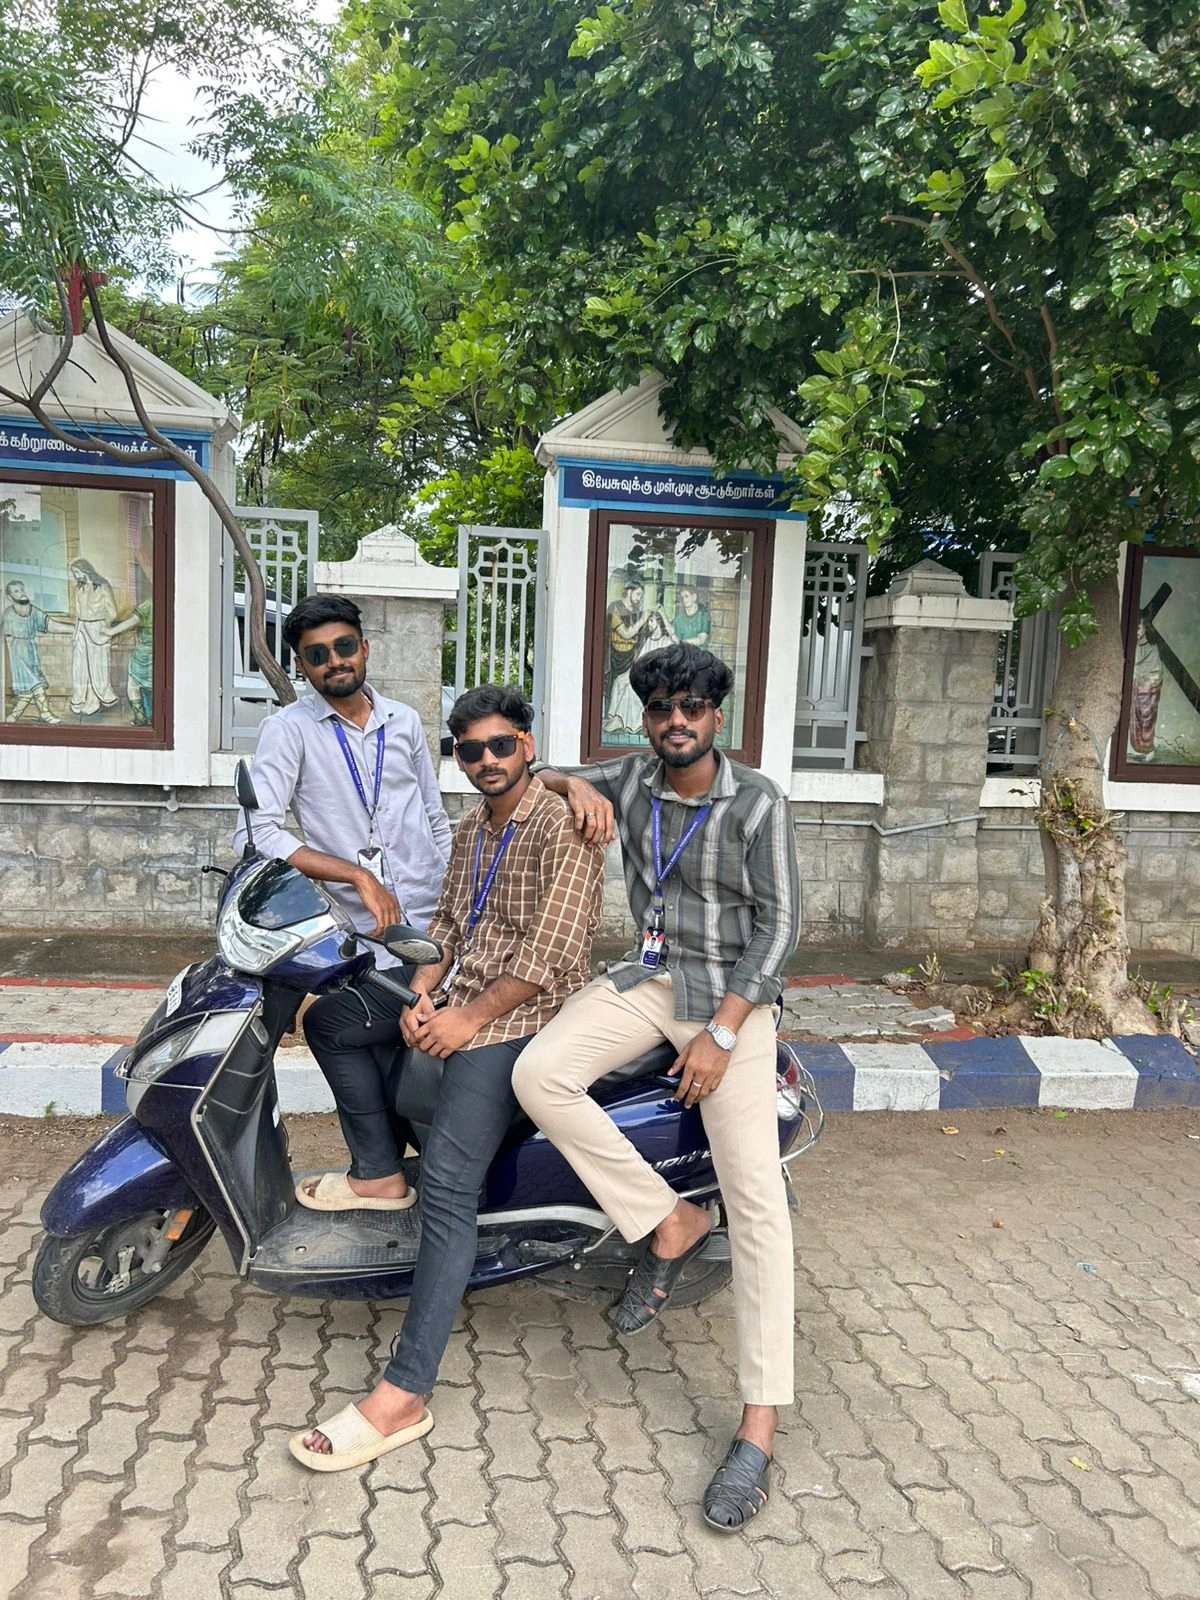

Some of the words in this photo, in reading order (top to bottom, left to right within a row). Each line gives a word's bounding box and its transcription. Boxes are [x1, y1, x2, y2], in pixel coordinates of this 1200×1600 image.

[581, 470, 652, 495] இயேசுவுக்கு
[653, 477, 694, 497] முள்முடி
[694, 481, 775, 500] சூட்டுகிறார்கள்
